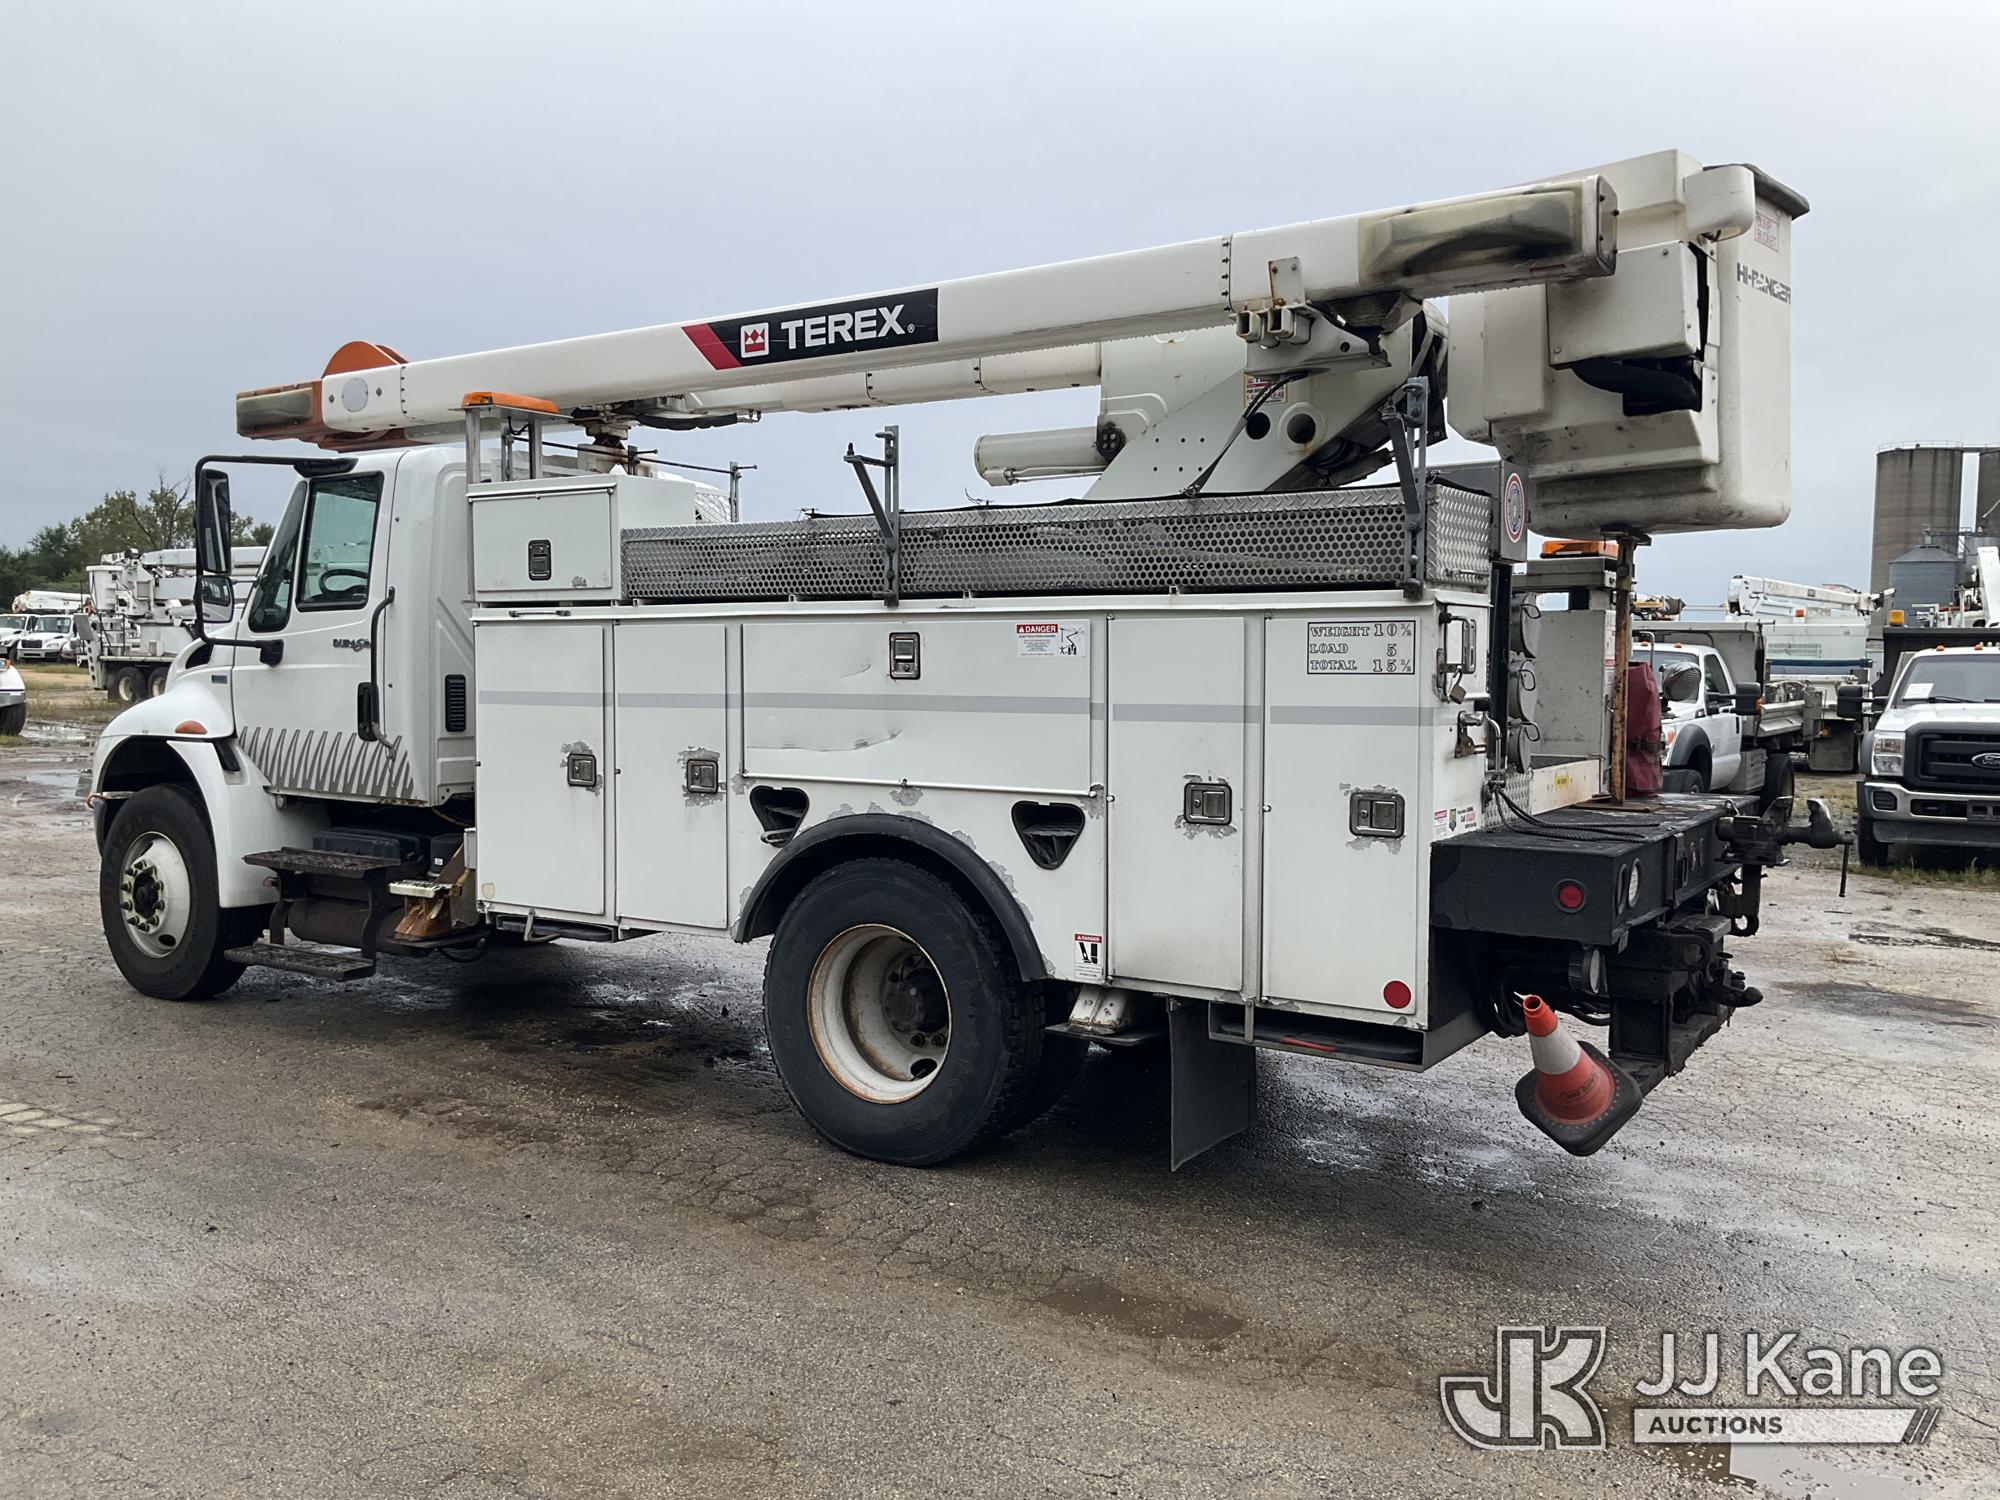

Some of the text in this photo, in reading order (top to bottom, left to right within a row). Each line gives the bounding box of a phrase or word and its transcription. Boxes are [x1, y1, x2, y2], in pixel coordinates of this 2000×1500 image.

[781, 304, 906, 350] TEREX
[1025, 625, 1057, 633] DANGER
[1310, 626, 1371, 637] WEIGHT
[1373, 623, 1398, 637] 10
[1309, 643, 1397, 657] LOAD 5
[1310, 660, 1358, 671] TOTAL
[1373, 659, 1397, 672] 15
